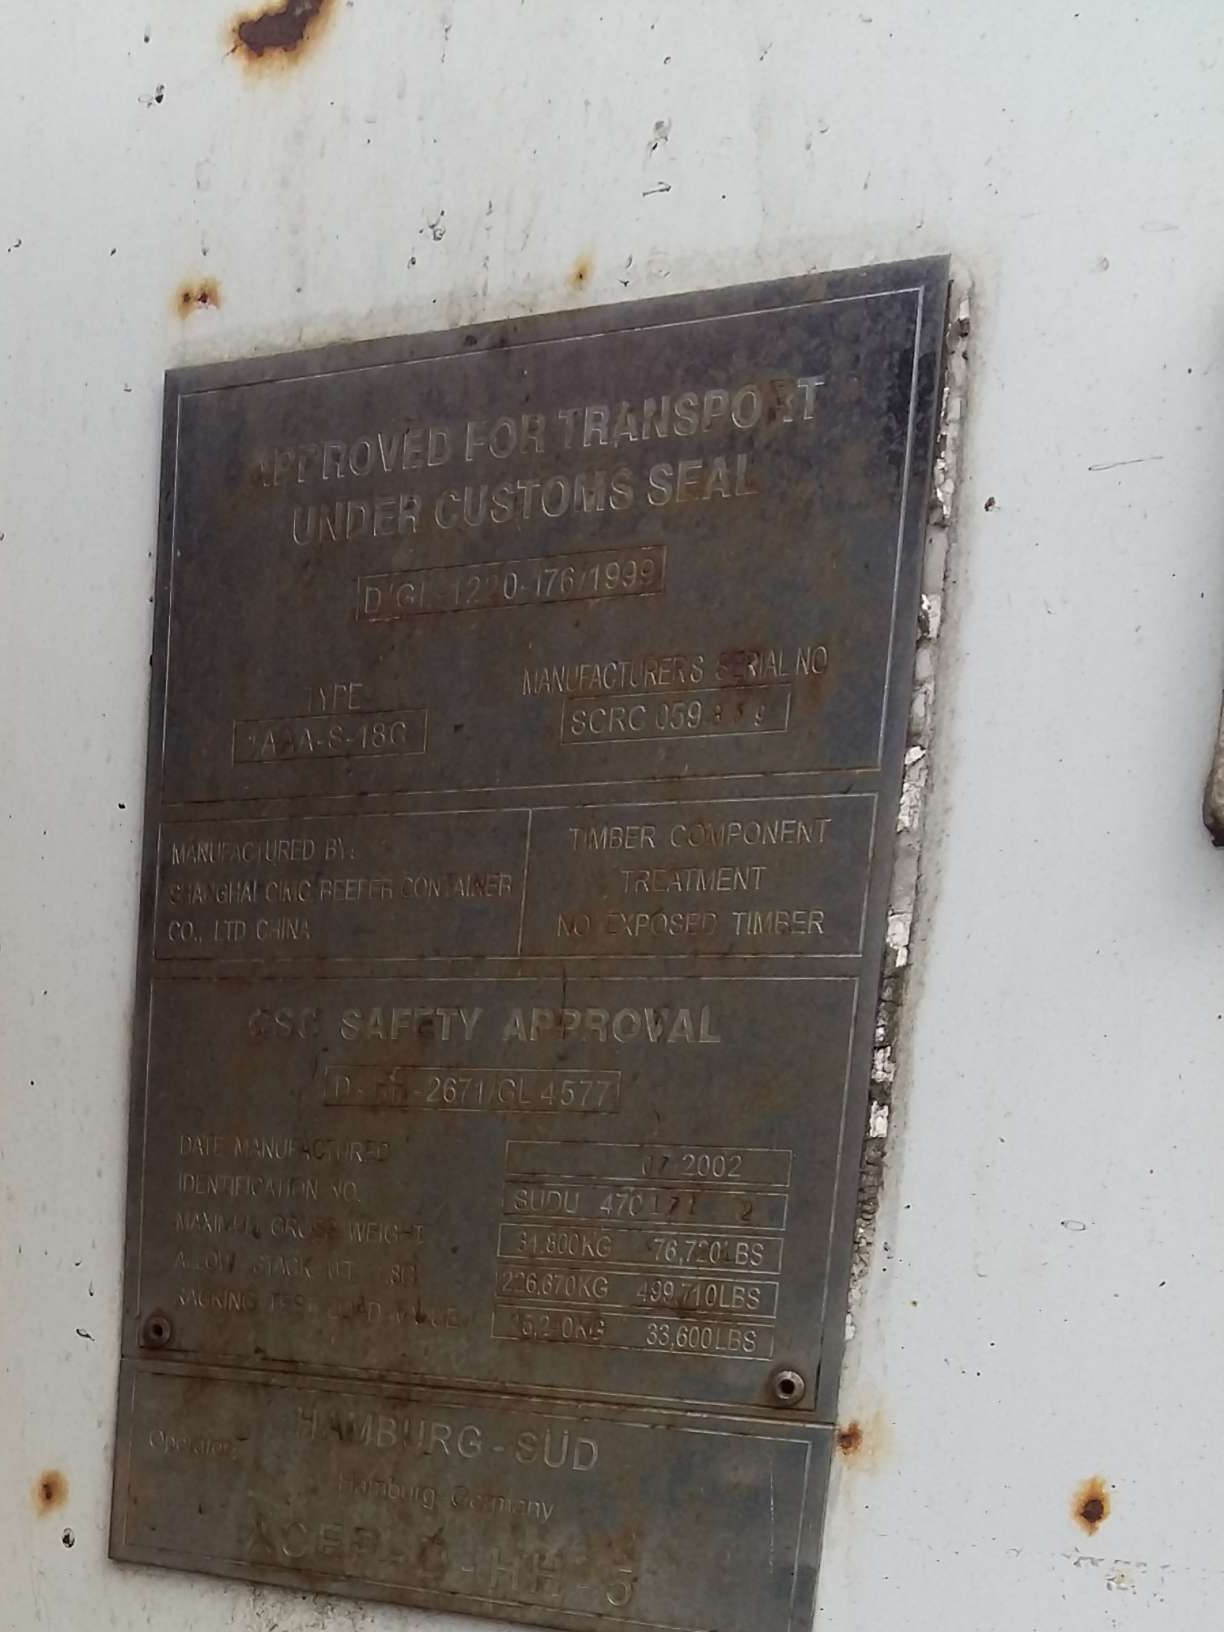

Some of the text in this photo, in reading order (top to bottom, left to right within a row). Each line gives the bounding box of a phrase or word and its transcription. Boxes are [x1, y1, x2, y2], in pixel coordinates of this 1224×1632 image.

[464, 413, 546, 464] FOR
[291, 452, 761, 547] UNDER CUSTOMS SEAL
[304, 682, 364, 713] TYPE
[570, 703, 647, 737] SCRC
[568, 818, 832, 851] TIMBER COMPONENT
[171, 838, 316, 866] MANUFACTURED
[620, 865, 768, 894] TREATMENT
[256, 917, 312, 943] CHINA
[555, 910, 825, 938] NO EXPOSED TIMBER
[339, 1007, 484, 1041] SAFETY
[502, 1006, 721, 1045] APPROVAL
[178, 1136, 225, 1157] DATE
[681, 1154, 743, 1179] 2002
[513, 1187, 581, 1213] SUDU
[646, 1323, 758, 1353] 33,600LBS
